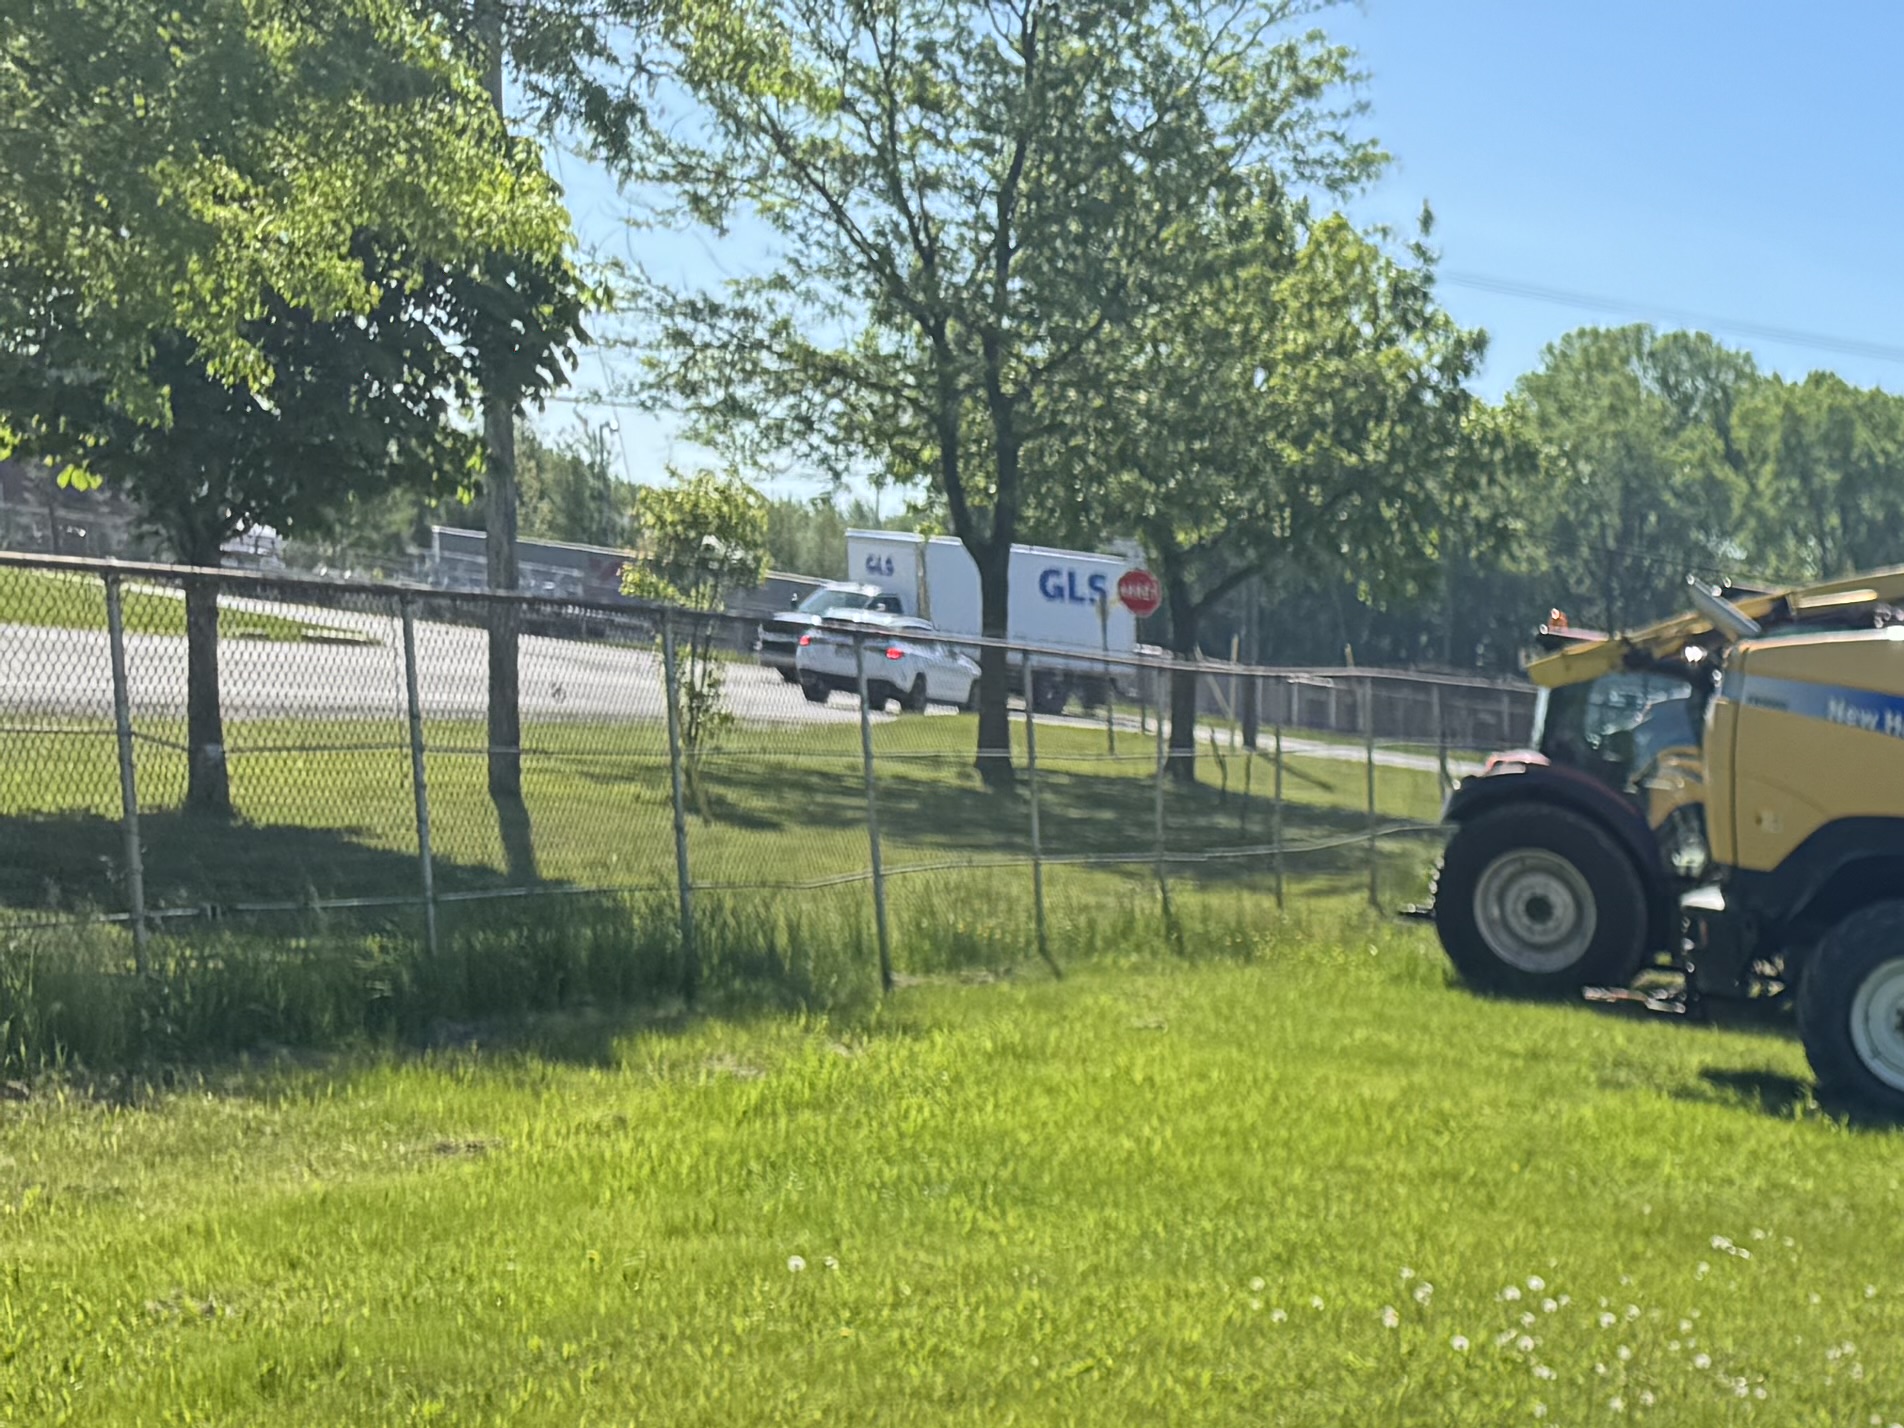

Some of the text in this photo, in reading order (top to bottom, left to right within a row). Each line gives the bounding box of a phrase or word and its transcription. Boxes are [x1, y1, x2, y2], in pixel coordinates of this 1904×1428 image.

[865, 553, 895, 577] GLS
[1038, 568, 1108, 605] GLS
[1827, 698, 1880, 731] New
